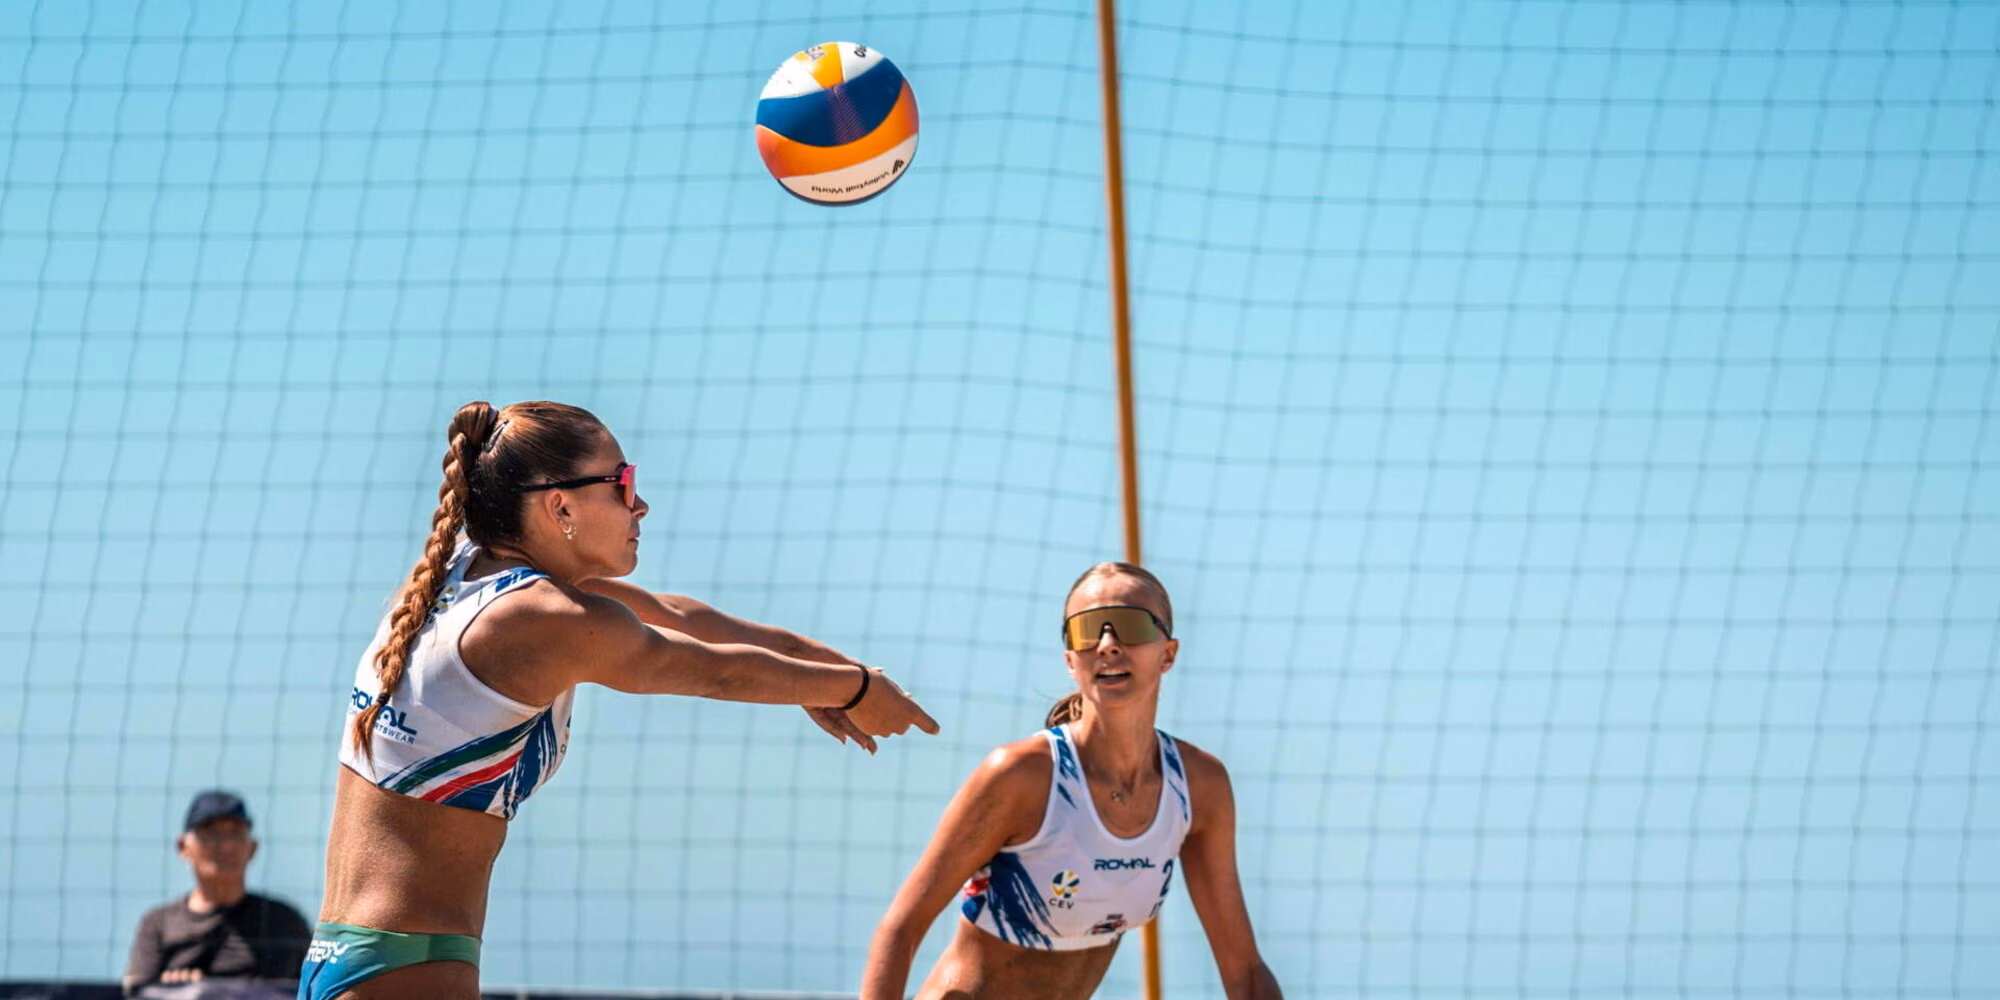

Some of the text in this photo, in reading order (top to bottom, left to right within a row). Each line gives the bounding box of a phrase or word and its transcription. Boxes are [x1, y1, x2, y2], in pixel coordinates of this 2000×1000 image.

[811, 171, 890, 194] Volleyball World
[1094, 857, 1156, 871] ROYAL
[1159, 858, 1174, 897] 2
[1048, 897, 1075, 910] CEV
